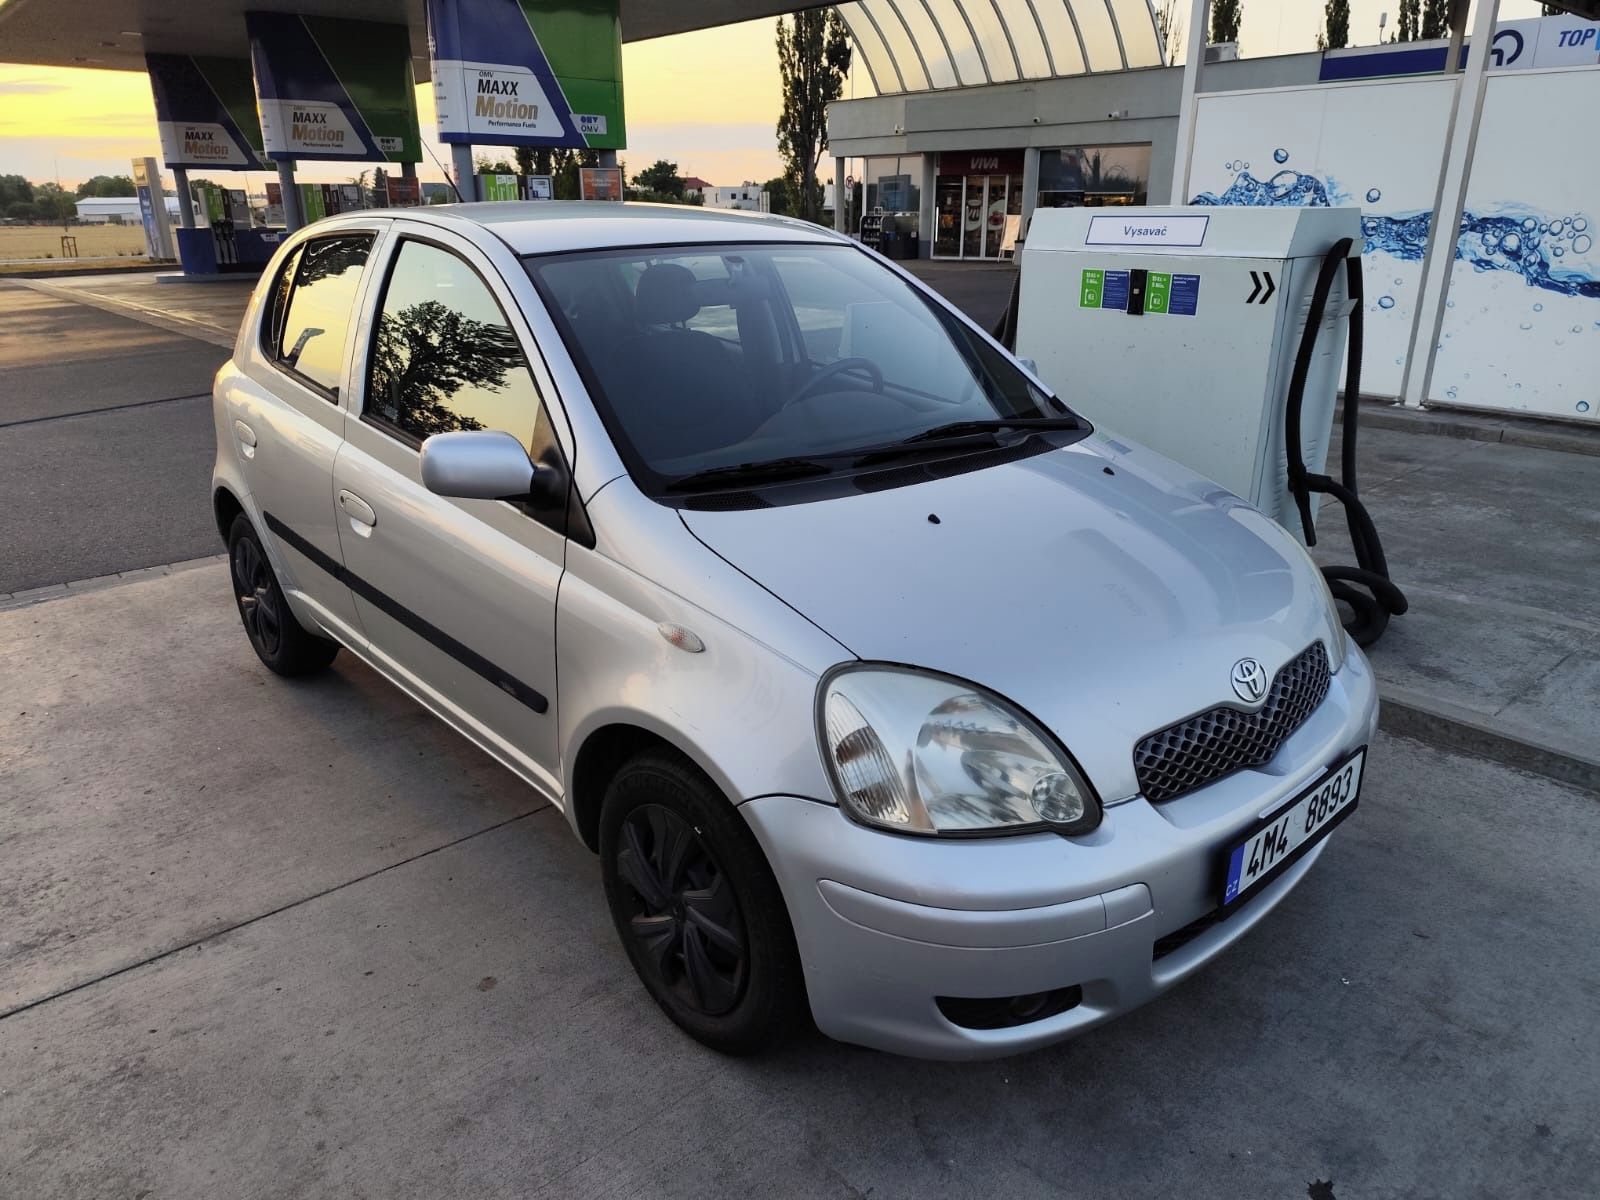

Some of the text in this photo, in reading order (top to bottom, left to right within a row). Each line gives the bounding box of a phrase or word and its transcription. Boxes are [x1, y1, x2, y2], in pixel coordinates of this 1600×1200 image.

[1558, 28, 1597, 48] TOP
[477, 79, 520, 96] MAXX
[475, 95, 539, 120] Motion
[292, 111, 327, 124] MAXX
[488, 119, 537, 129] Performance Fuels
[184, 131, 214, 141] MAXX
[291, 124, 345, 142] Motion
[580, 124, 599, 133] OMV
[184, 140, 229, 155] Motion
[970, 157, 999, 170] VIVA
[1123, 225, 1168, 238] Vysavač
[1246, 765, 1353, 878] 4M4 8893
[1225, 879, 1239, 897] CZ
